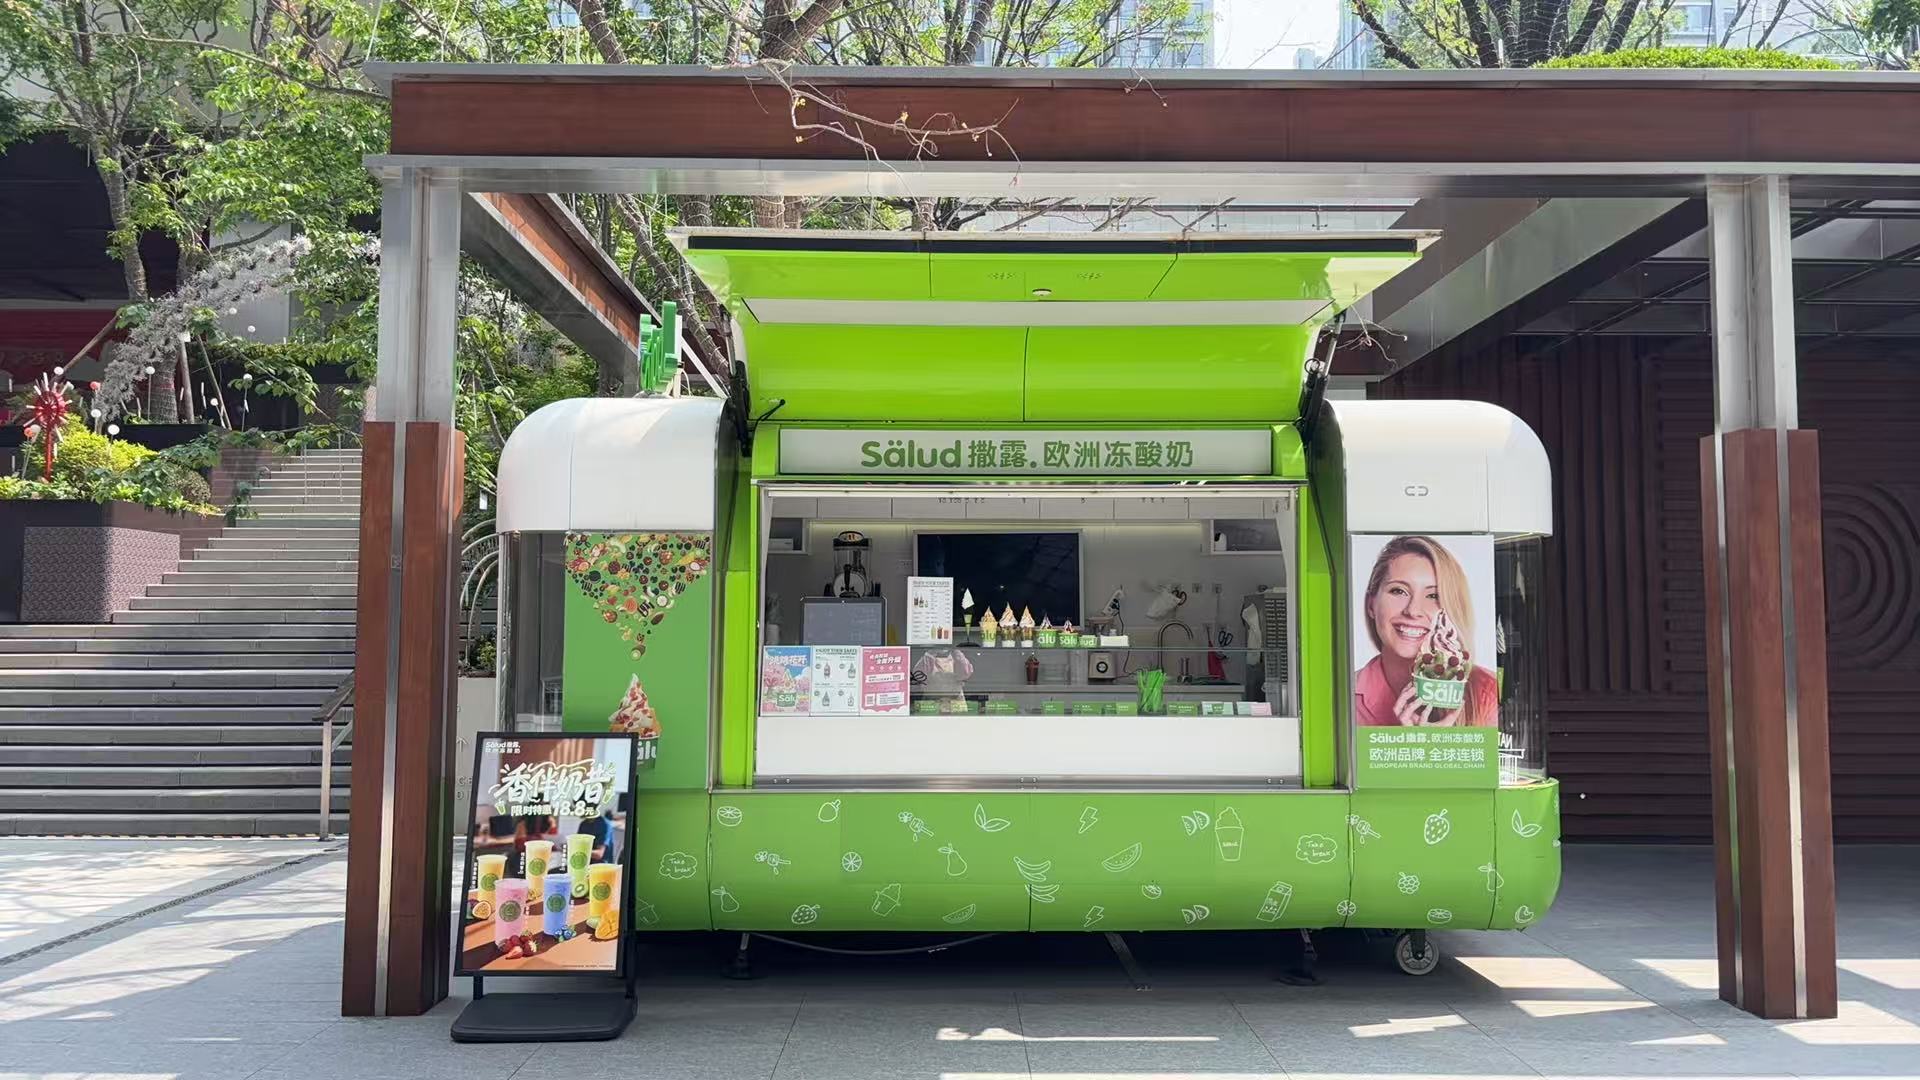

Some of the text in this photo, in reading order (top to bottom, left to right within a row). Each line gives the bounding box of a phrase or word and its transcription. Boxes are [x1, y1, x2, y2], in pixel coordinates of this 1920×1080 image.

[861, 440, 961, 468] Sälud
[1369, 748, 1484, 761] 欧洲品牌 全球连锁
